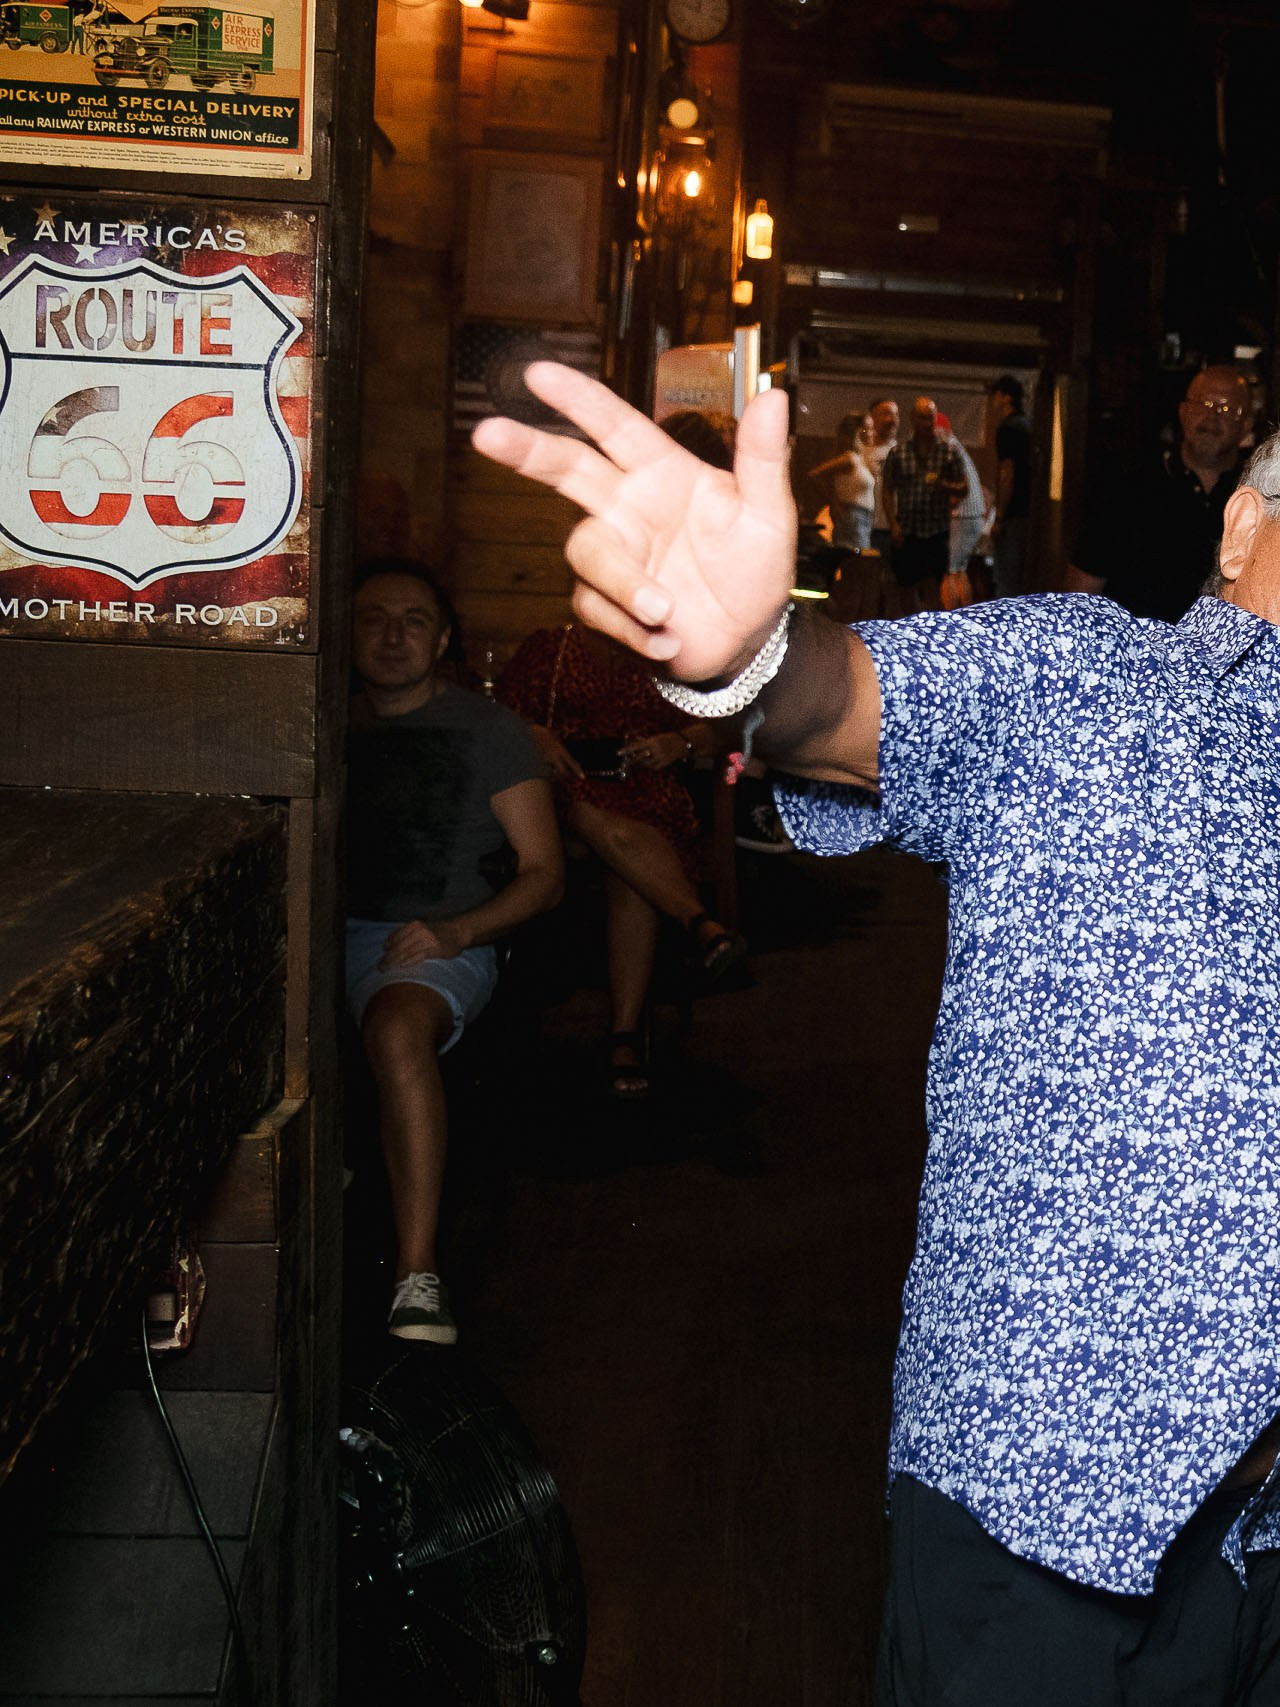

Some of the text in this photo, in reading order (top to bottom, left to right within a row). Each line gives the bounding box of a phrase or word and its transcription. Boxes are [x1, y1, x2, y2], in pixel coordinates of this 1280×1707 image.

[224, 25, 261, 36] EXPRESS
[225, 15, 243, 24] AIR
[224, 34, 260, 48] SERVICE
[0, 88, 295, 118] PICK-UP and SPECIAL DELIVERY
[67, 107, 206, 126] without extra cost
[14, 118, 34, 129] any
[37, 117, 84, 130] RAILWAY
[87, 120, 136, 134] EXPRESS
[138, 126, 151, 135] or
[152, 125, 207, 138] WESTERN
[211, 128, 251, 141] UNION
[254, 132, 289, 144] office
[33, 220, 247, 253] AMERICA'S
[35, 284, 234, 356] ROUTE
[27, 385, 246, 545] 66
[0, 598, 279, 627] MOTHER ROAD
